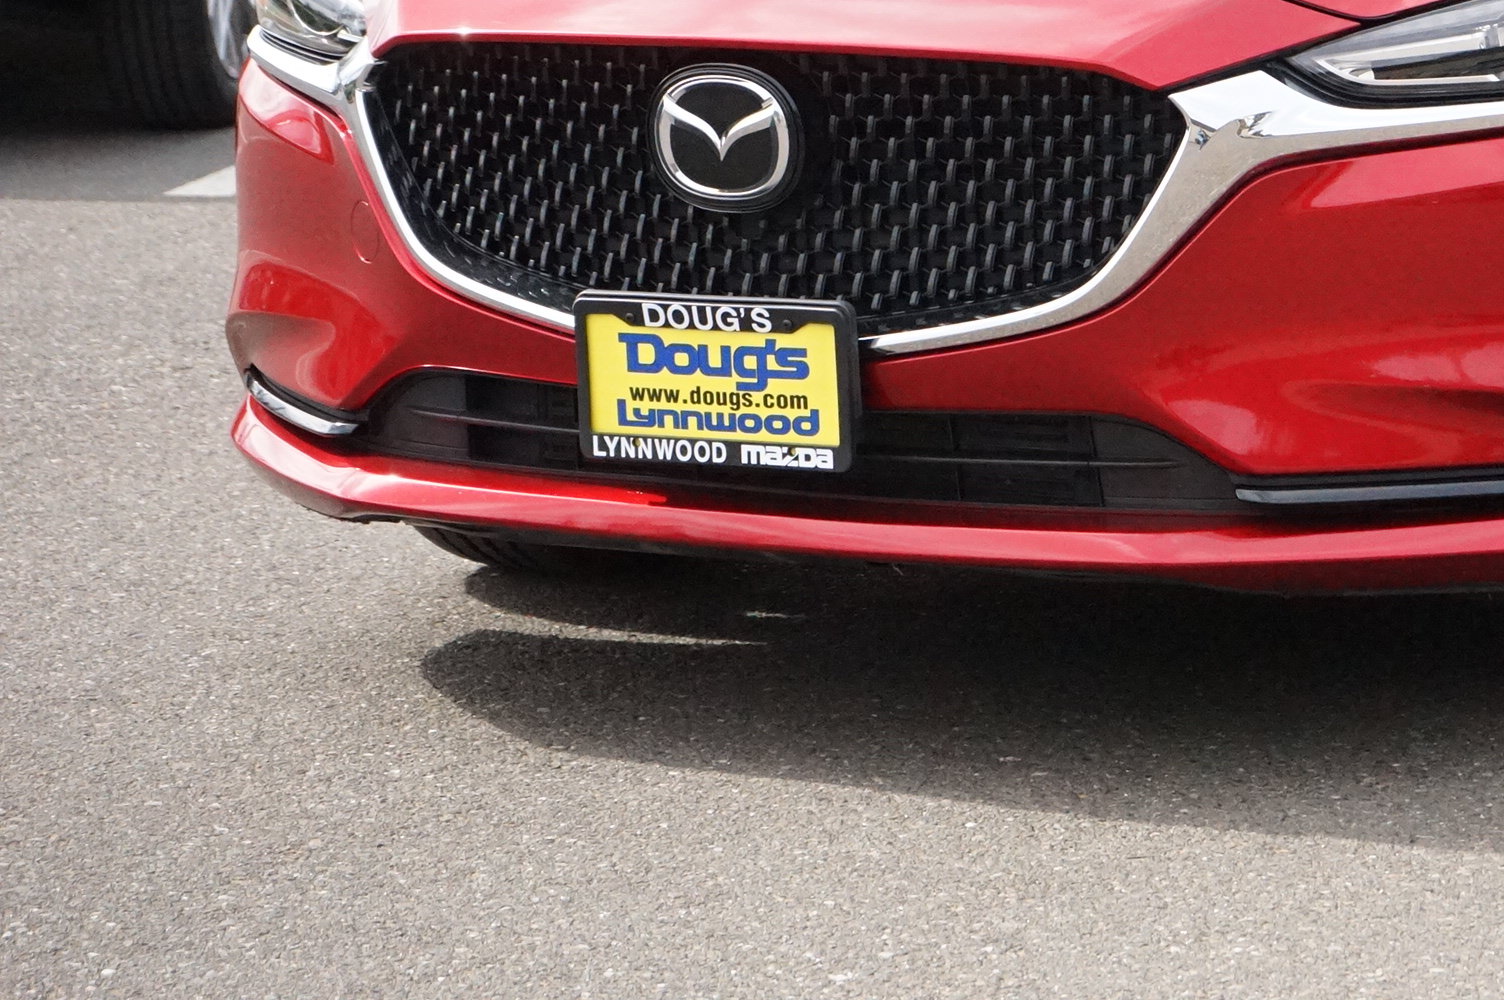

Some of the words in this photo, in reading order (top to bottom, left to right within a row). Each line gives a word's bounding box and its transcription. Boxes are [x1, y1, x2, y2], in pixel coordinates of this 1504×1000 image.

[641, 302, 773, 333] DOUG'S
[629, 386, 809, 411] www.dougs.com
[617, 398, 820, 436] Lynnwood
[592, 435, 728, 464] LYNNWOOD
